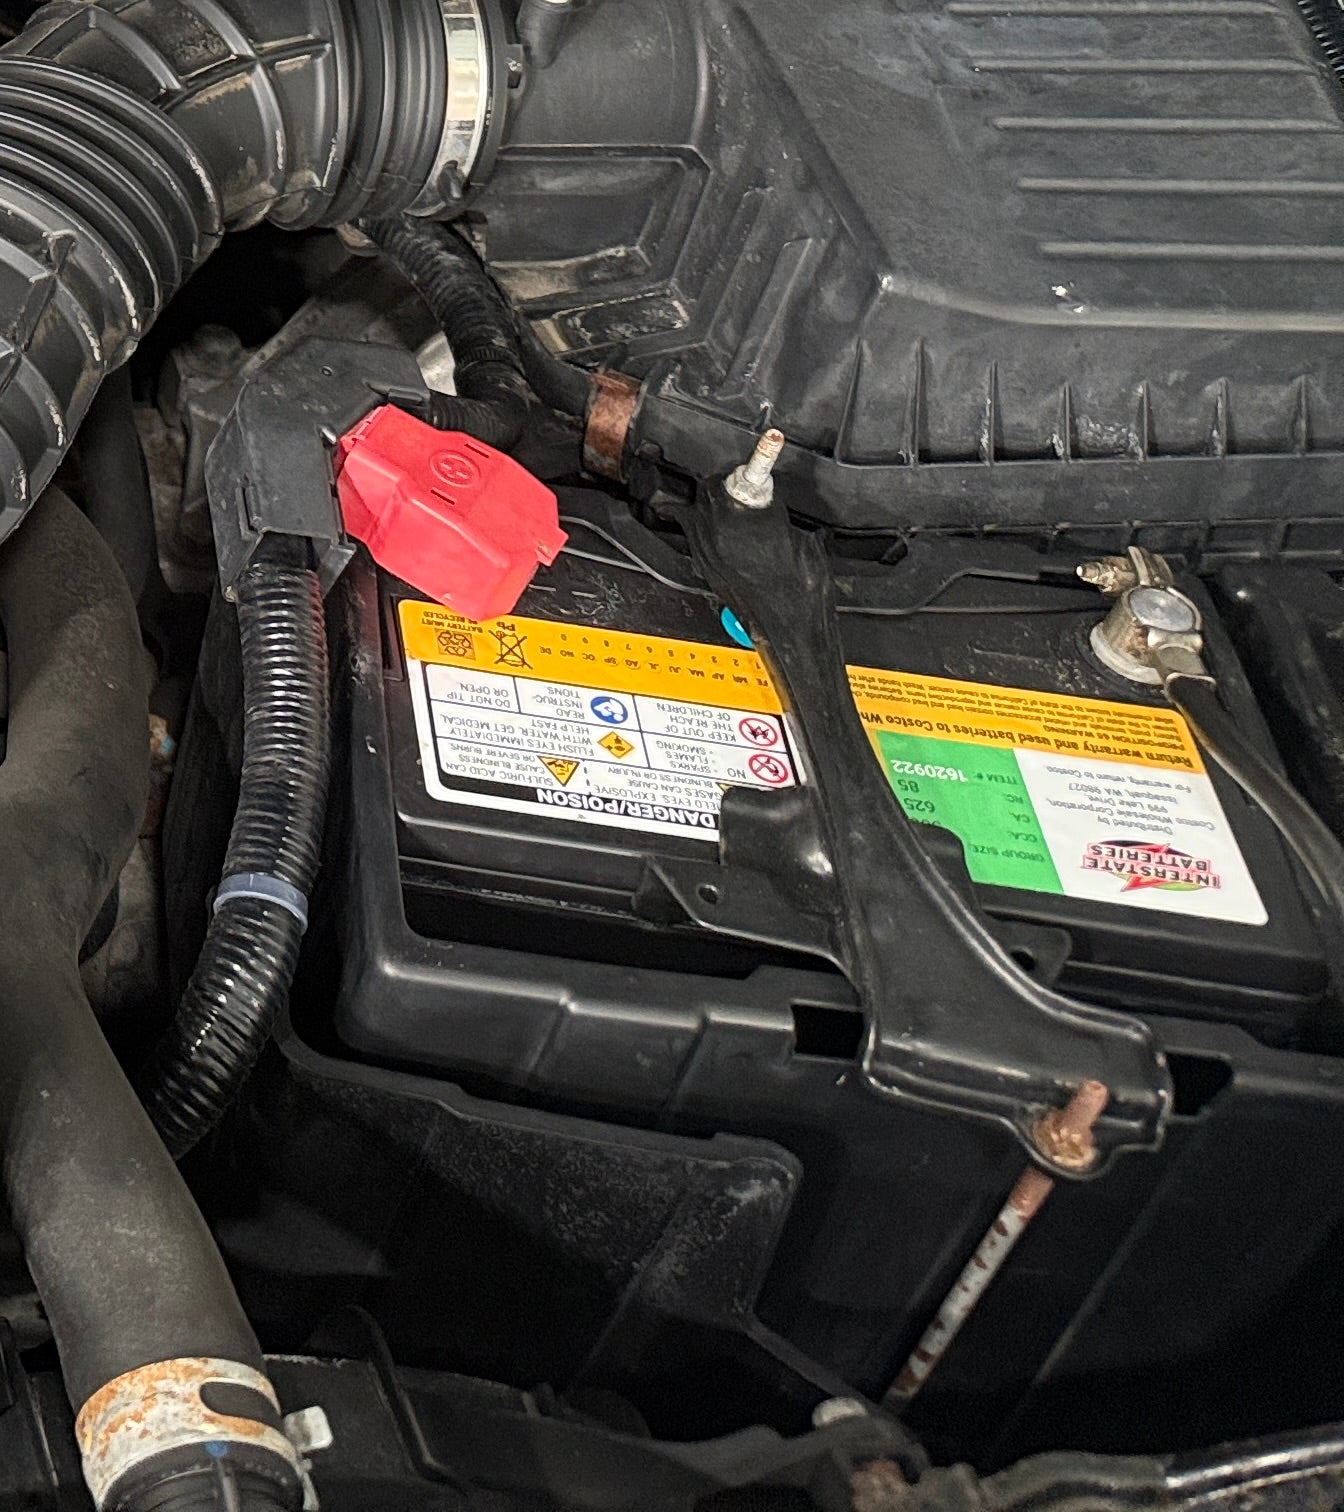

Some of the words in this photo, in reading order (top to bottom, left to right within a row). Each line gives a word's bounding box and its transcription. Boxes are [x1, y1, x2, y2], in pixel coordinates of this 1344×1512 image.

[496, 621, 515, 631] Pb
[447, 692, 464, 701] TIP
[494, 688, 508, 697] OR
[469, 695, 492, 705] NOT
[494, 699, 510, 709] DO
[533, 694, 583, 709] INSTRUC-
[556, 708, 585, 719] READ
[656, 703, 712, 719] CHILDREN
[716, 712, 730, 721] OF
[440, 714, 490, 730] MEDICAL
[530, 719, 557, 730] FAST
[670, 715, 707, 728] REACH
[712, 721, 733, 732] THE
[885, 715, 933, 732] Costco
[494, 724, 515, 735] GET
[559, 724, 589, 734] HELP
[664, 725, 678, 733] OF
[682, 728, 704, 738] OUT
[936, 723, 950, 733] to
[953, 725, 1016, 742] batteries
[450, 727, 524, 746] IMMEDIATELY
[561, 735, 592, 745] WITH
[707, 732, 736, 742] KEEP
[1018, 733, 1051, 746] used
[526, 739, 554, 750] EYES
[557, 744, 594, 756] FLUSH
[656, 740, 706, 754] SMOKING
[1054, 739, 1079, 750] and
[1083, 741, 1143, 759] warranty
[486, 748, 520, 760] SEVERE
[522, 754, 536, 763] OR
[665, 751, 708, 764] FLAMES
[458, 754, 511, 770] BLINDNESS
[1145, 752, 1193, 768] Return
[446, 762, 466, 772] CAN
[470, 766, 496, 777] ACID
[514, 762, 545, 774] CAUSE
[669, 761, 711, 774] SPARKS
[890, 759, 968, 783] 1620922
[499, 770, 553, 786] SULFURIC
[644, 772, 657, 780] OR
[727, 768, 746, 779] NO
[1096, 774, 1125, 782] return
[627, 779, 658, 790] CAUSE
[659, 774, 713, 788] BLINDNESS
[987, 774, 1017, 785] ITEM
[661, 784, 681, 793] CAN
[897, 779, 920, 793] 85
[1175, 784, 1192, 793] For
[594, 785, 656, 801] EXPLOSIVE
[1104, 789, 1122, 797] WA
[536, 787, 715, 829] DANGER/POISON
[903, 798, 936, 813] 625
[1097, 815, 1110, 825] by
[1116, 809, 1173, 824] Wholesale
[1112, 818, 1173, 835] Distributed
[1175, 818, 1215, 830] Costco
[1001, 850, 1044, 862] GROUP
[1090, 844, 1208, 872] BATTERIES
[1084, 857, 1218, 887] INTERSTATE
